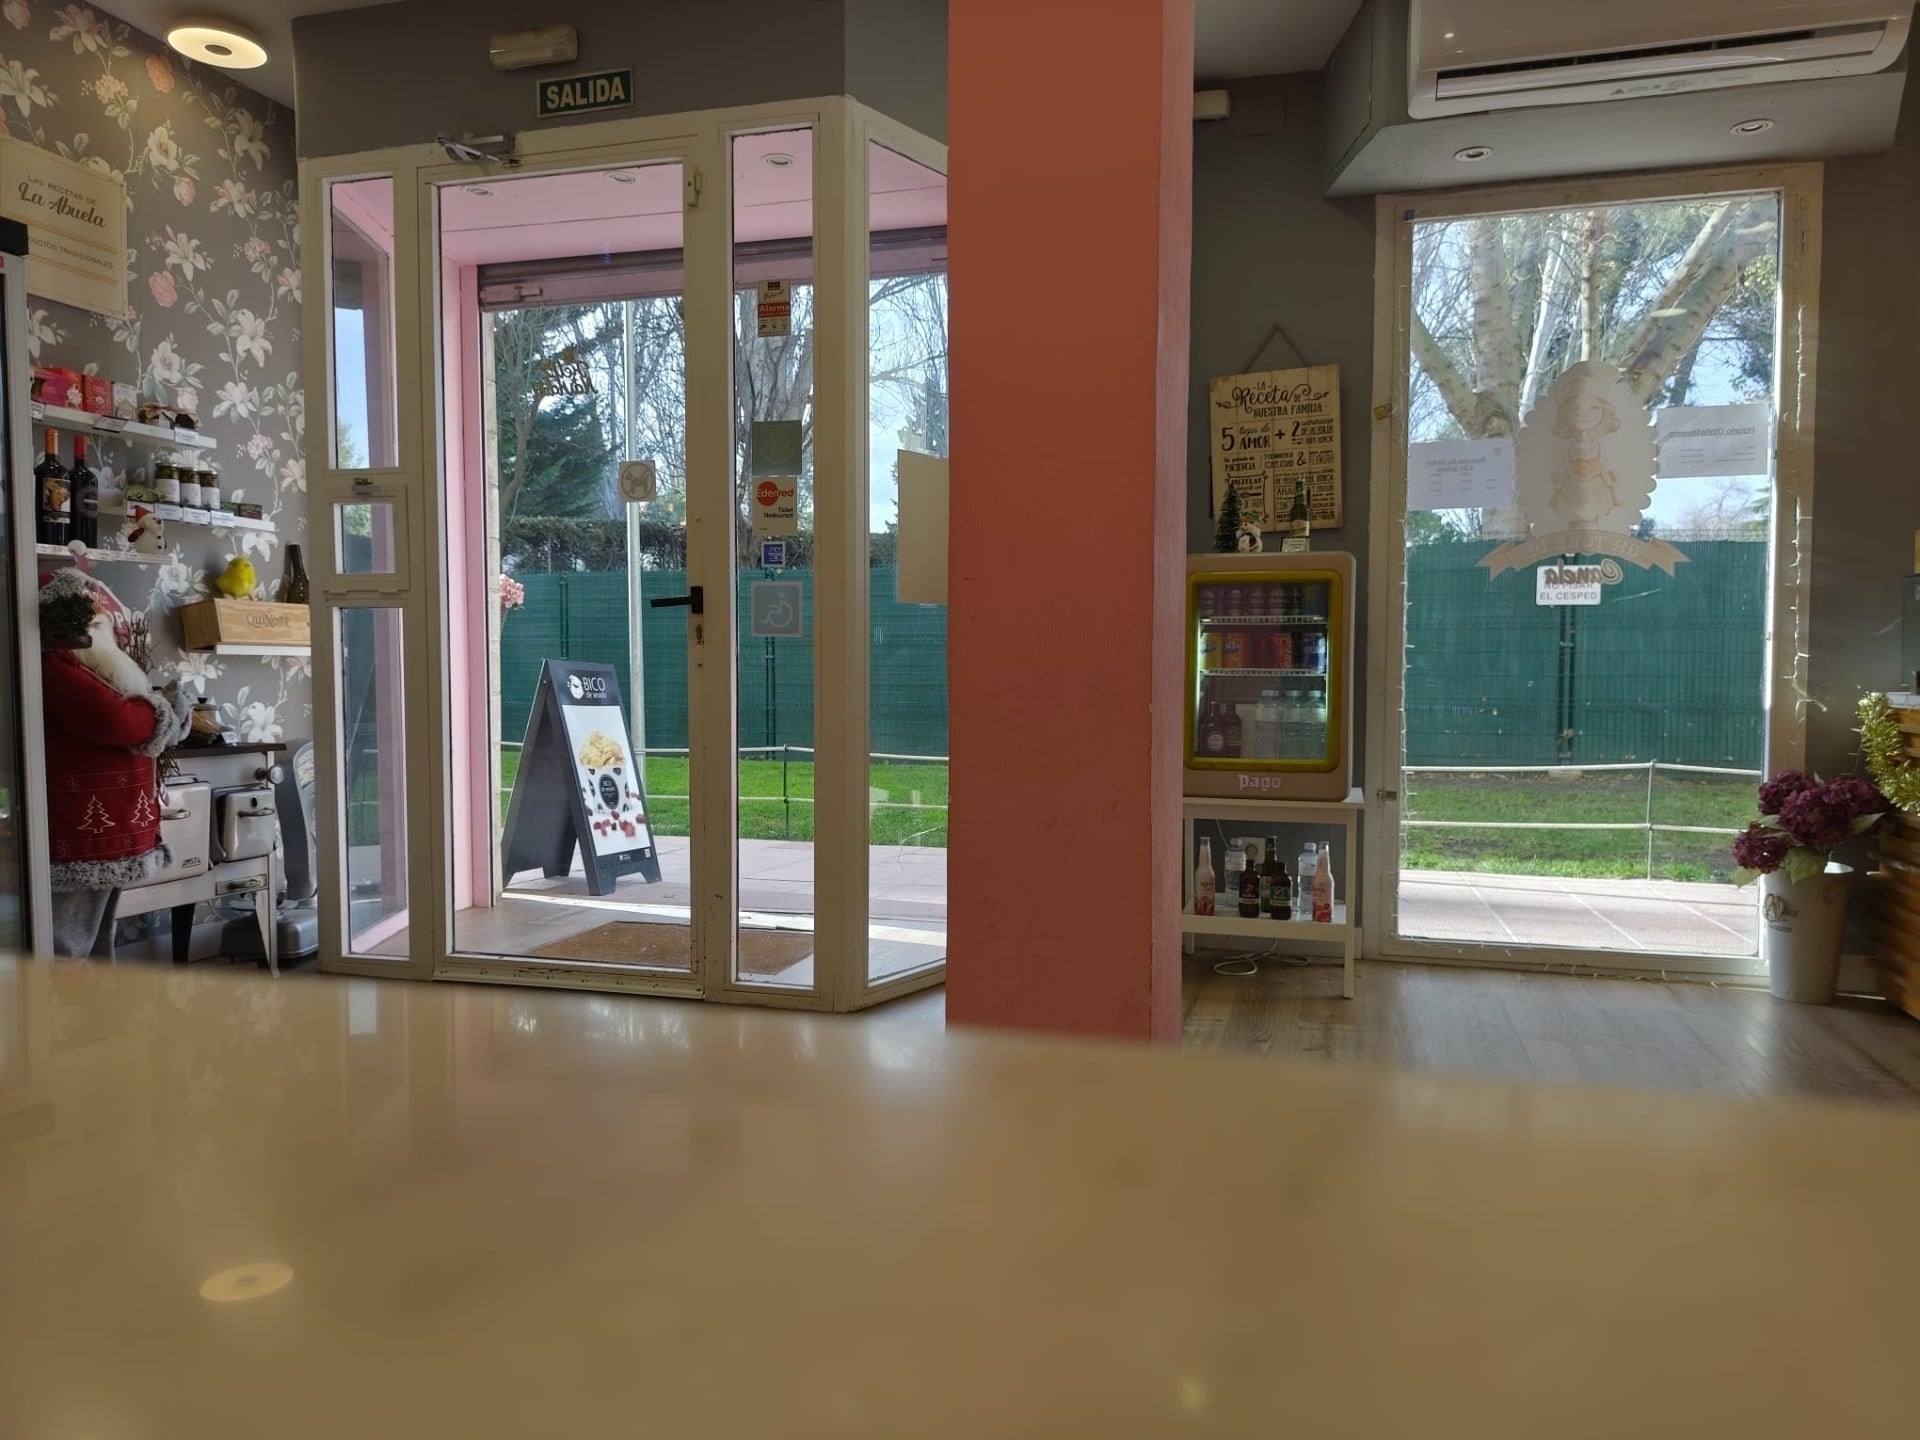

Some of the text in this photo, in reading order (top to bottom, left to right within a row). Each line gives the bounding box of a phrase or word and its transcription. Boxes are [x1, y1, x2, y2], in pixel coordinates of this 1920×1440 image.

[546, 76, 625, 109] SALIDA
[27, 173, 44, 187] LAS
[47, 182, 83, 201] RECETAS
[17, 181, 107, 228] La Abuela
[1257, 381, 1266, 391] LA
[1232, 384, 1303, 412] Receta
[1252, 402, 1323, 419] NUESTRA FAMILIA
[1221, 426, 1236, 452] 5
[1239, 435, 1272, 451] AMOR
[757, 487, 794, 499] Edenred
[1539, 591, 1597, 601] EL CESPED
[582, 676, 606, 692] BICO
